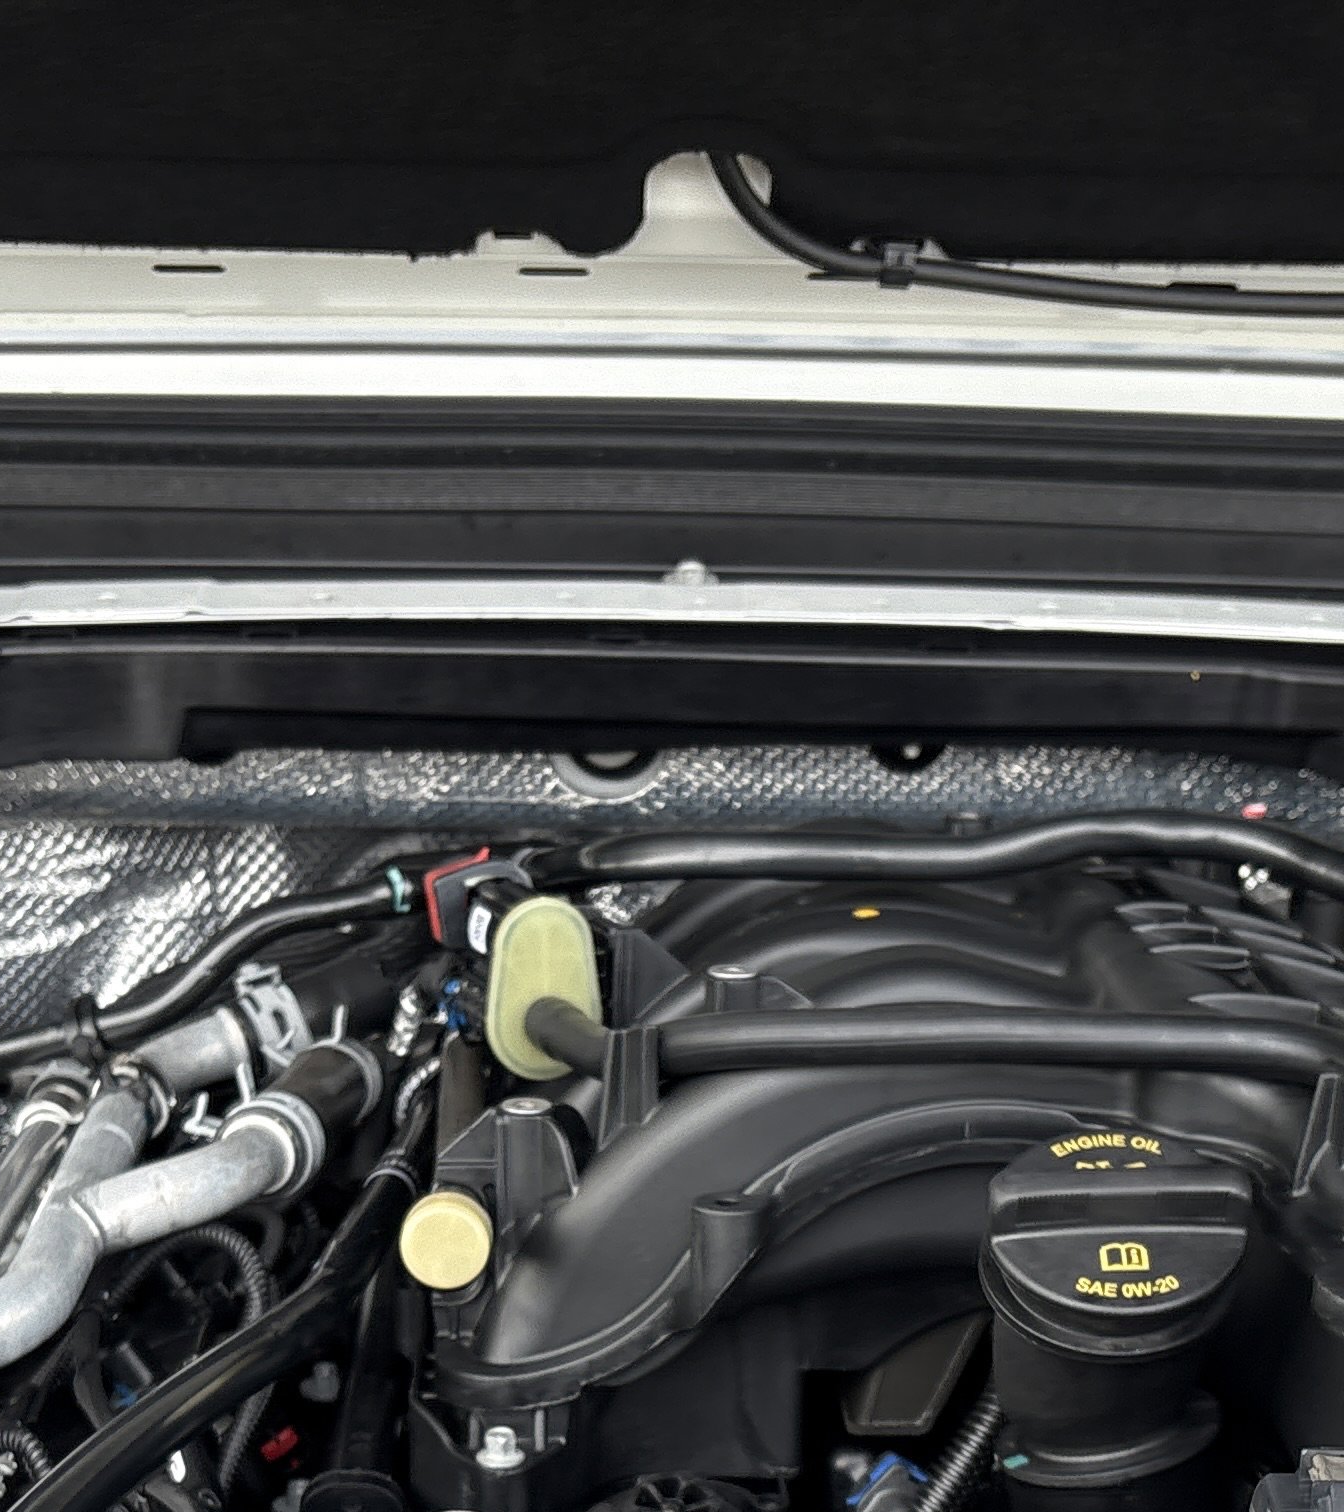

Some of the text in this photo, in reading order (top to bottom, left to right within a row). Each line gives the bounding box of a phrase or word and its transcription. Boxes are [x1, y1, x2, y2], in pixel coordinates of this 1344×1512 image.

[1050, 1134, 1163, 1157] ENGINE OIL
[1075, 1275, 1180, 1298] SAE 0W-20
